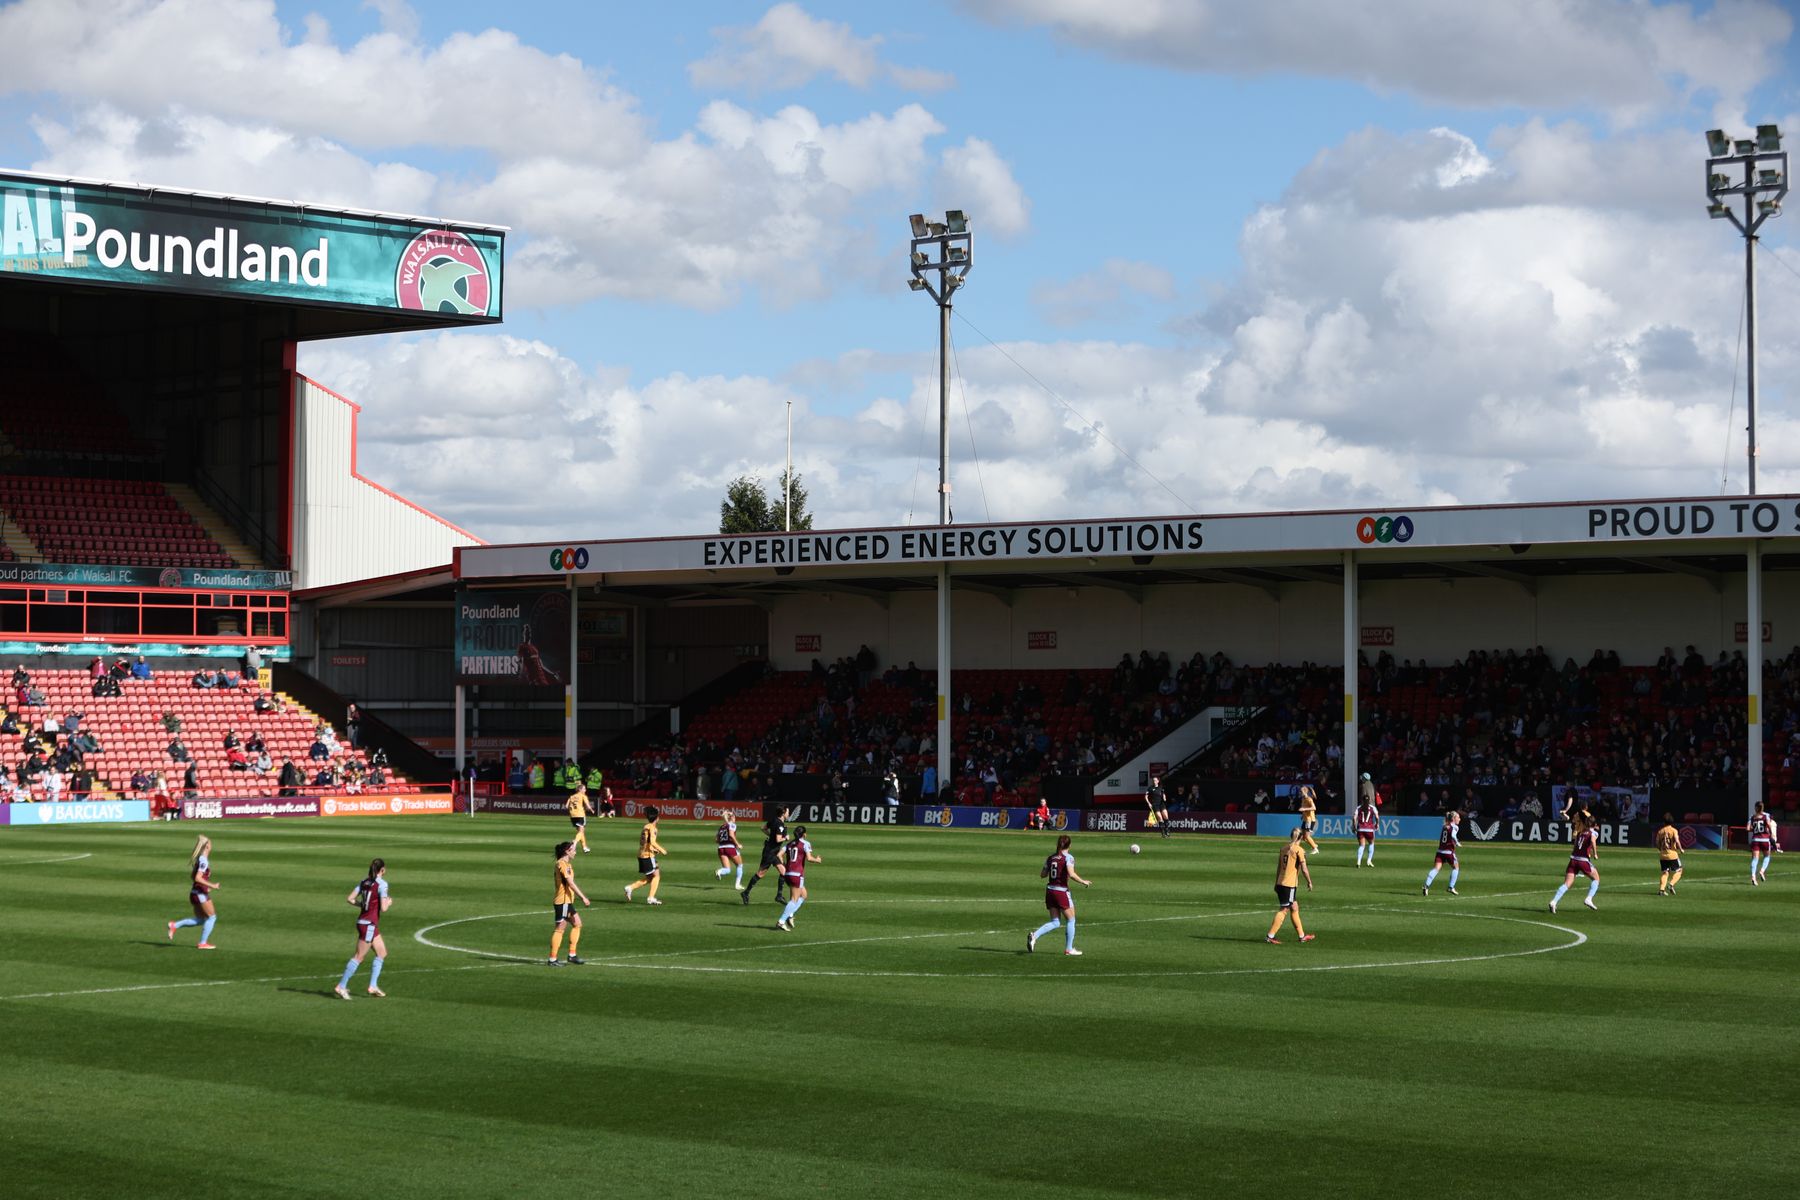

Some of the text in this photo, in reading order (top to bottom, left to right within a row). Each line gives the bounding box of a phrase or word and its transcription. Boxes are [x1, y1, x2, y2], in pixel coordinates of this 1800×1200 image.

[0, 187, 87, 255] ALL
[64, 211, 328, 286] Poundland
[403, 234, 467, 285] WALSALL FC
[1588, 505, 1714, 537] PROUD
[1729, 503, 1779, 533] TO
[704, 522, 1203, 566] EXPERIENCED ENERGY SOLUTIONS
[20, 568, 63, 582] partners
[67, 568, 79, 581] of
[81, 569, 116, 582] Walsall
[118, 570, 132, 582] FC
[193, 574, 250, 586] Poundland
[461, 604, 520, 619] Poundland
[461, 624, 519, 651] PROUD
[1048, 632, 1057, 647] B
[1383, 628, 1393, 643] C
[35, 644, 70, 653] Poundland
[107, 645, 141, 654] Poundland
[811, 636, 820, 650] A
[177, 646, 210, 655] Poundland
[332, 657, 361, 665] TOILETS
[461, 655, 519, 675] PARTNERS
[225, 802, 318, 815] membership.avfc.co.uk
[336, 801, 387, 811] Trade Nation
[402, 799, 451, 809] Trade Nation
[493, 801, 520, 809] FOOTBALL
[533, 802, 548, 810] GAME
[661, 804, 688, 816] Nation
[55, 804, 124, 819] BARCLAYS
[195, 808, 223, 819] PRIDE
[731, 807, 760, 818] Nation
[809, 805, 898, 824] CASTORE
[924, 808, 954, 827] BK8
[1361, 810, 1371, 823] 17
[980, 809, 1010, 829] BK8
[1098, 820, 1127, 830] PRIDE
[1322, 818, 1400, 836] BARYS
[1511, 821, 1630, 844] CASTRE
[1753, 820, 1765, 834] 26
[1442, 832, 1448, 844] 8
[788, 846, 798, 863] 10
[1051, 861, 1058, 879] 6
